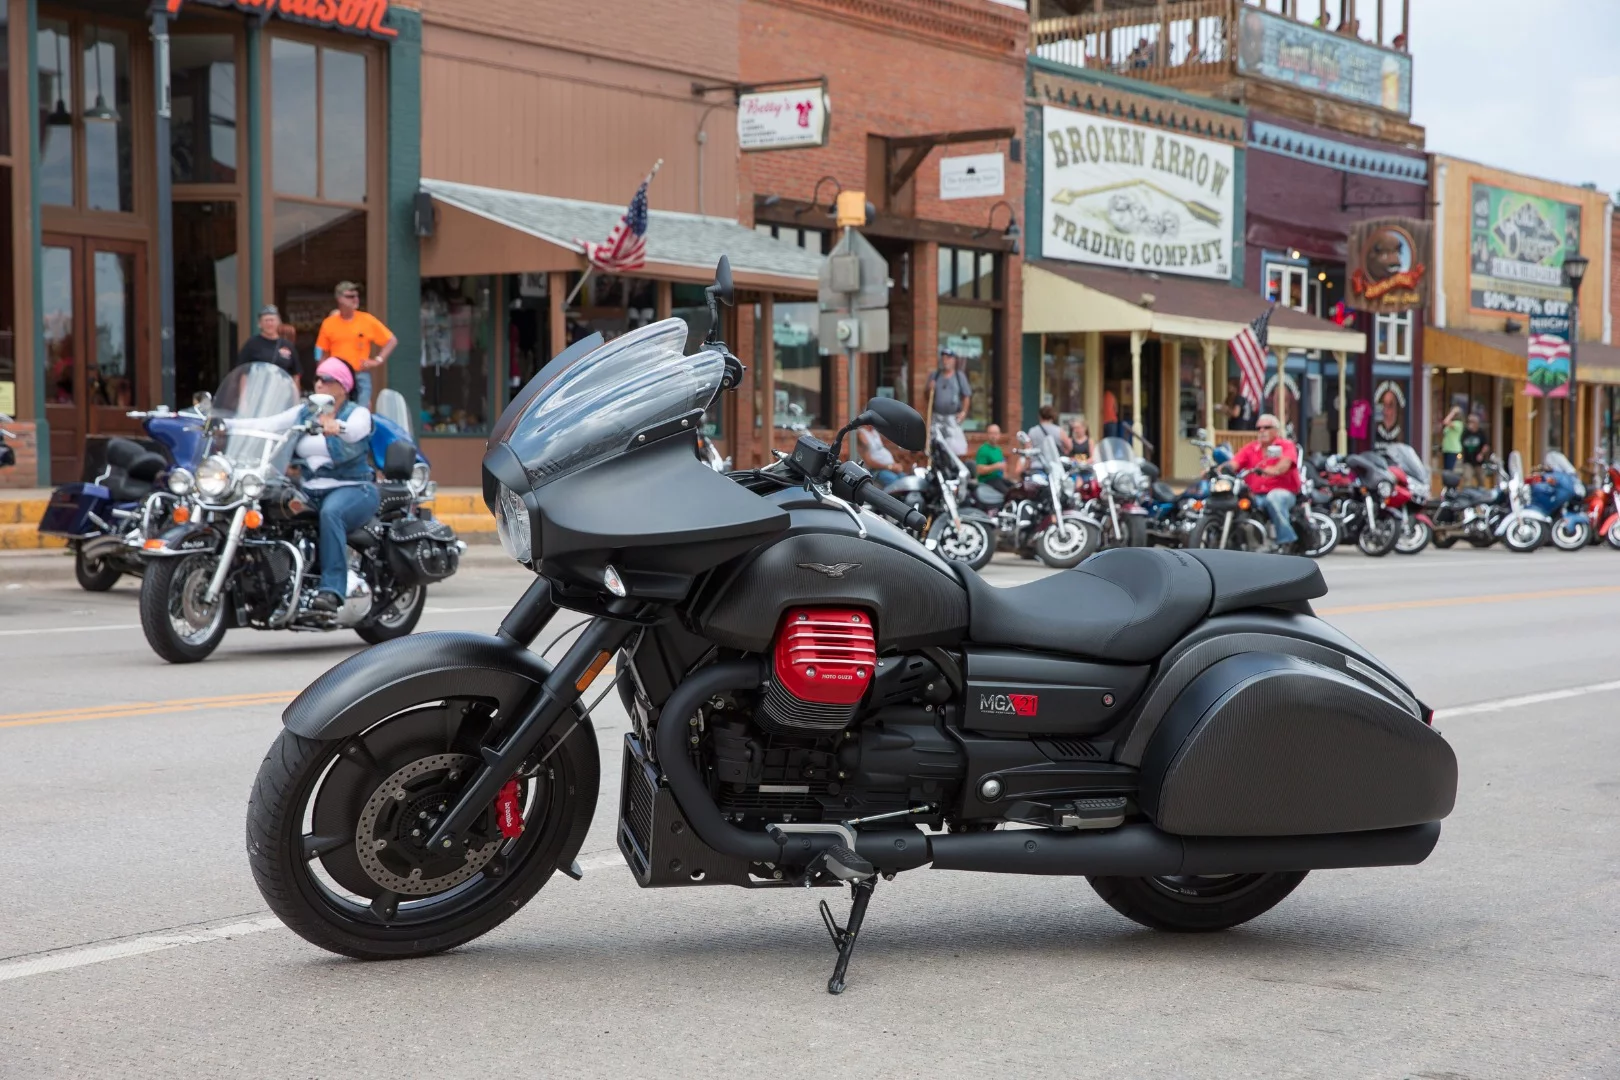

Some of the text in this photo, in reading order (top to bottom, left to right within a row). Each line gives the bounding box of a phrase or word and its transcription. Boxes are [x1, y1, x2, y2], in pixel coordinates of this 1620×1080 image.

[1048, 125, 1230, 197] BROKEN ARROW
[1052, 213, 1223, 267] TRADING COMPANY
[504, 801, 513, 828] brembo
